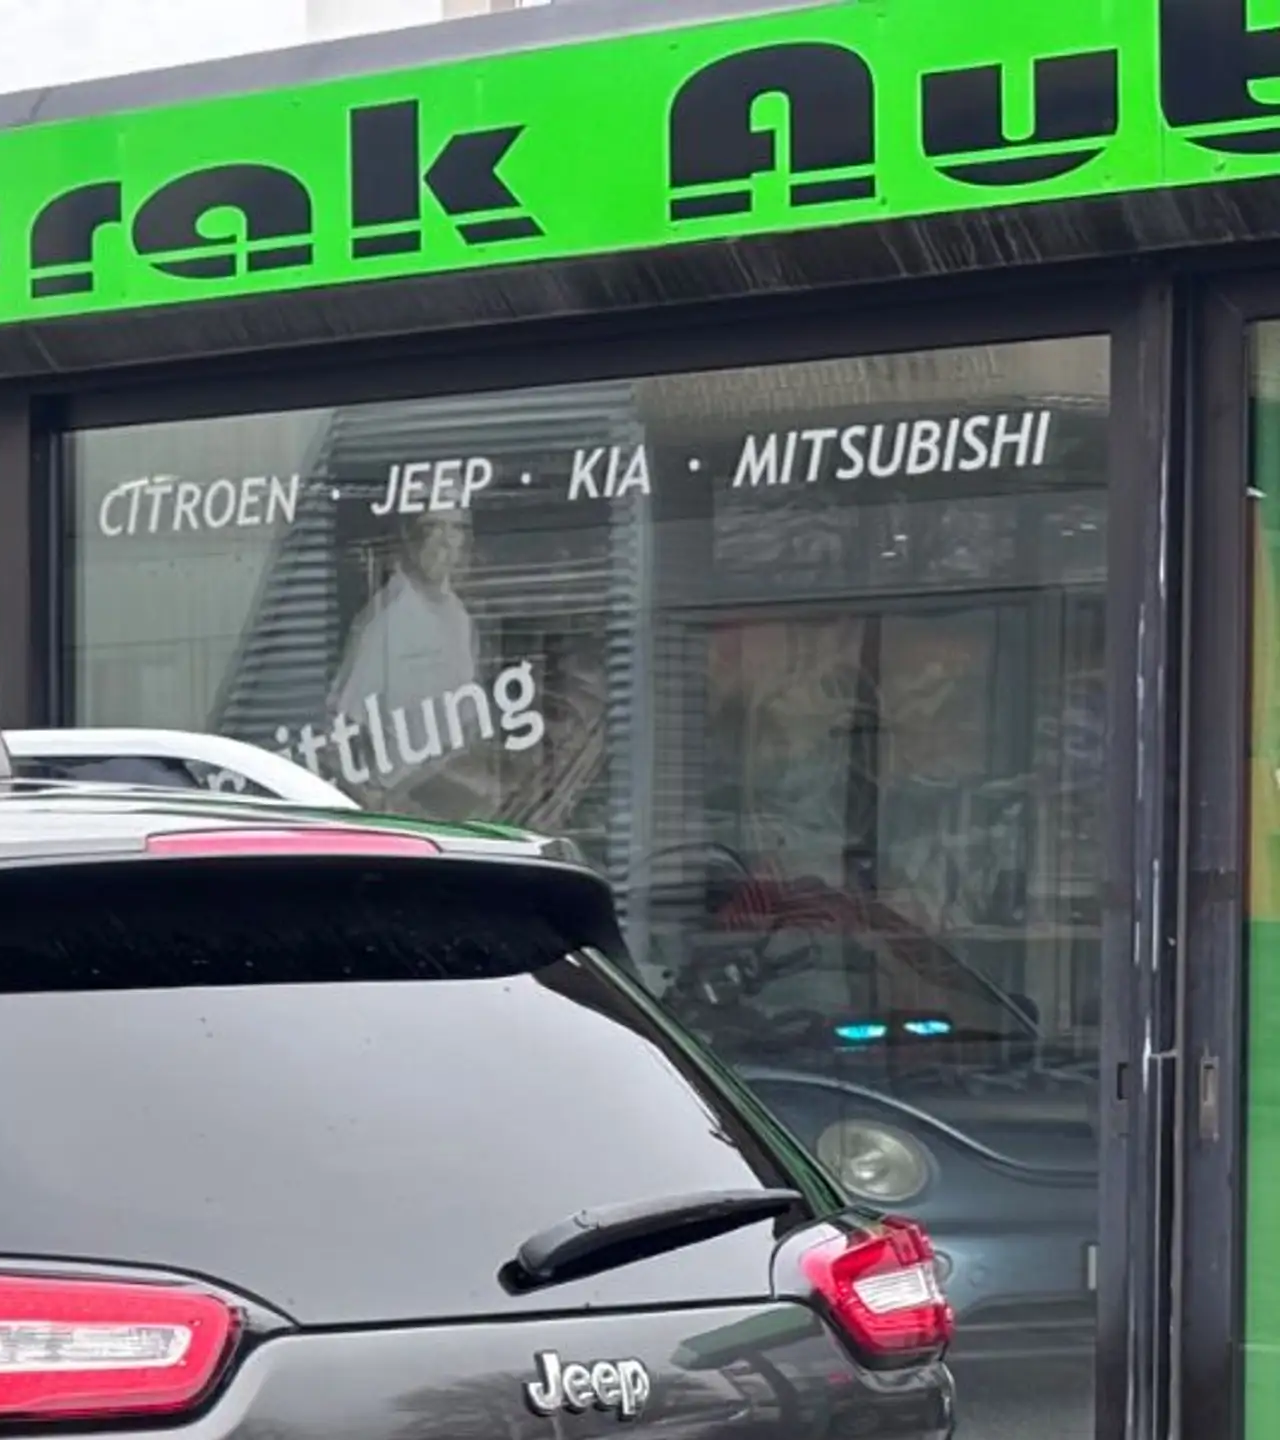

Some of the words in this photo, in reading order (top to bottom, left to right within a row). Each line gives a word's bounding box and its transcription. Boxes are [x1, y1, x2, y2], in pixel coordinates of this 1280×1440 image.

[99, 472, 300, 537] CITROEN
[371, 457, 493, 515] JEEP
[568, 444, 652, 500] KIA
[732, 411, 1051, 488] MITSUBISHI
[528, 1351, 651, 1418] Jeep
